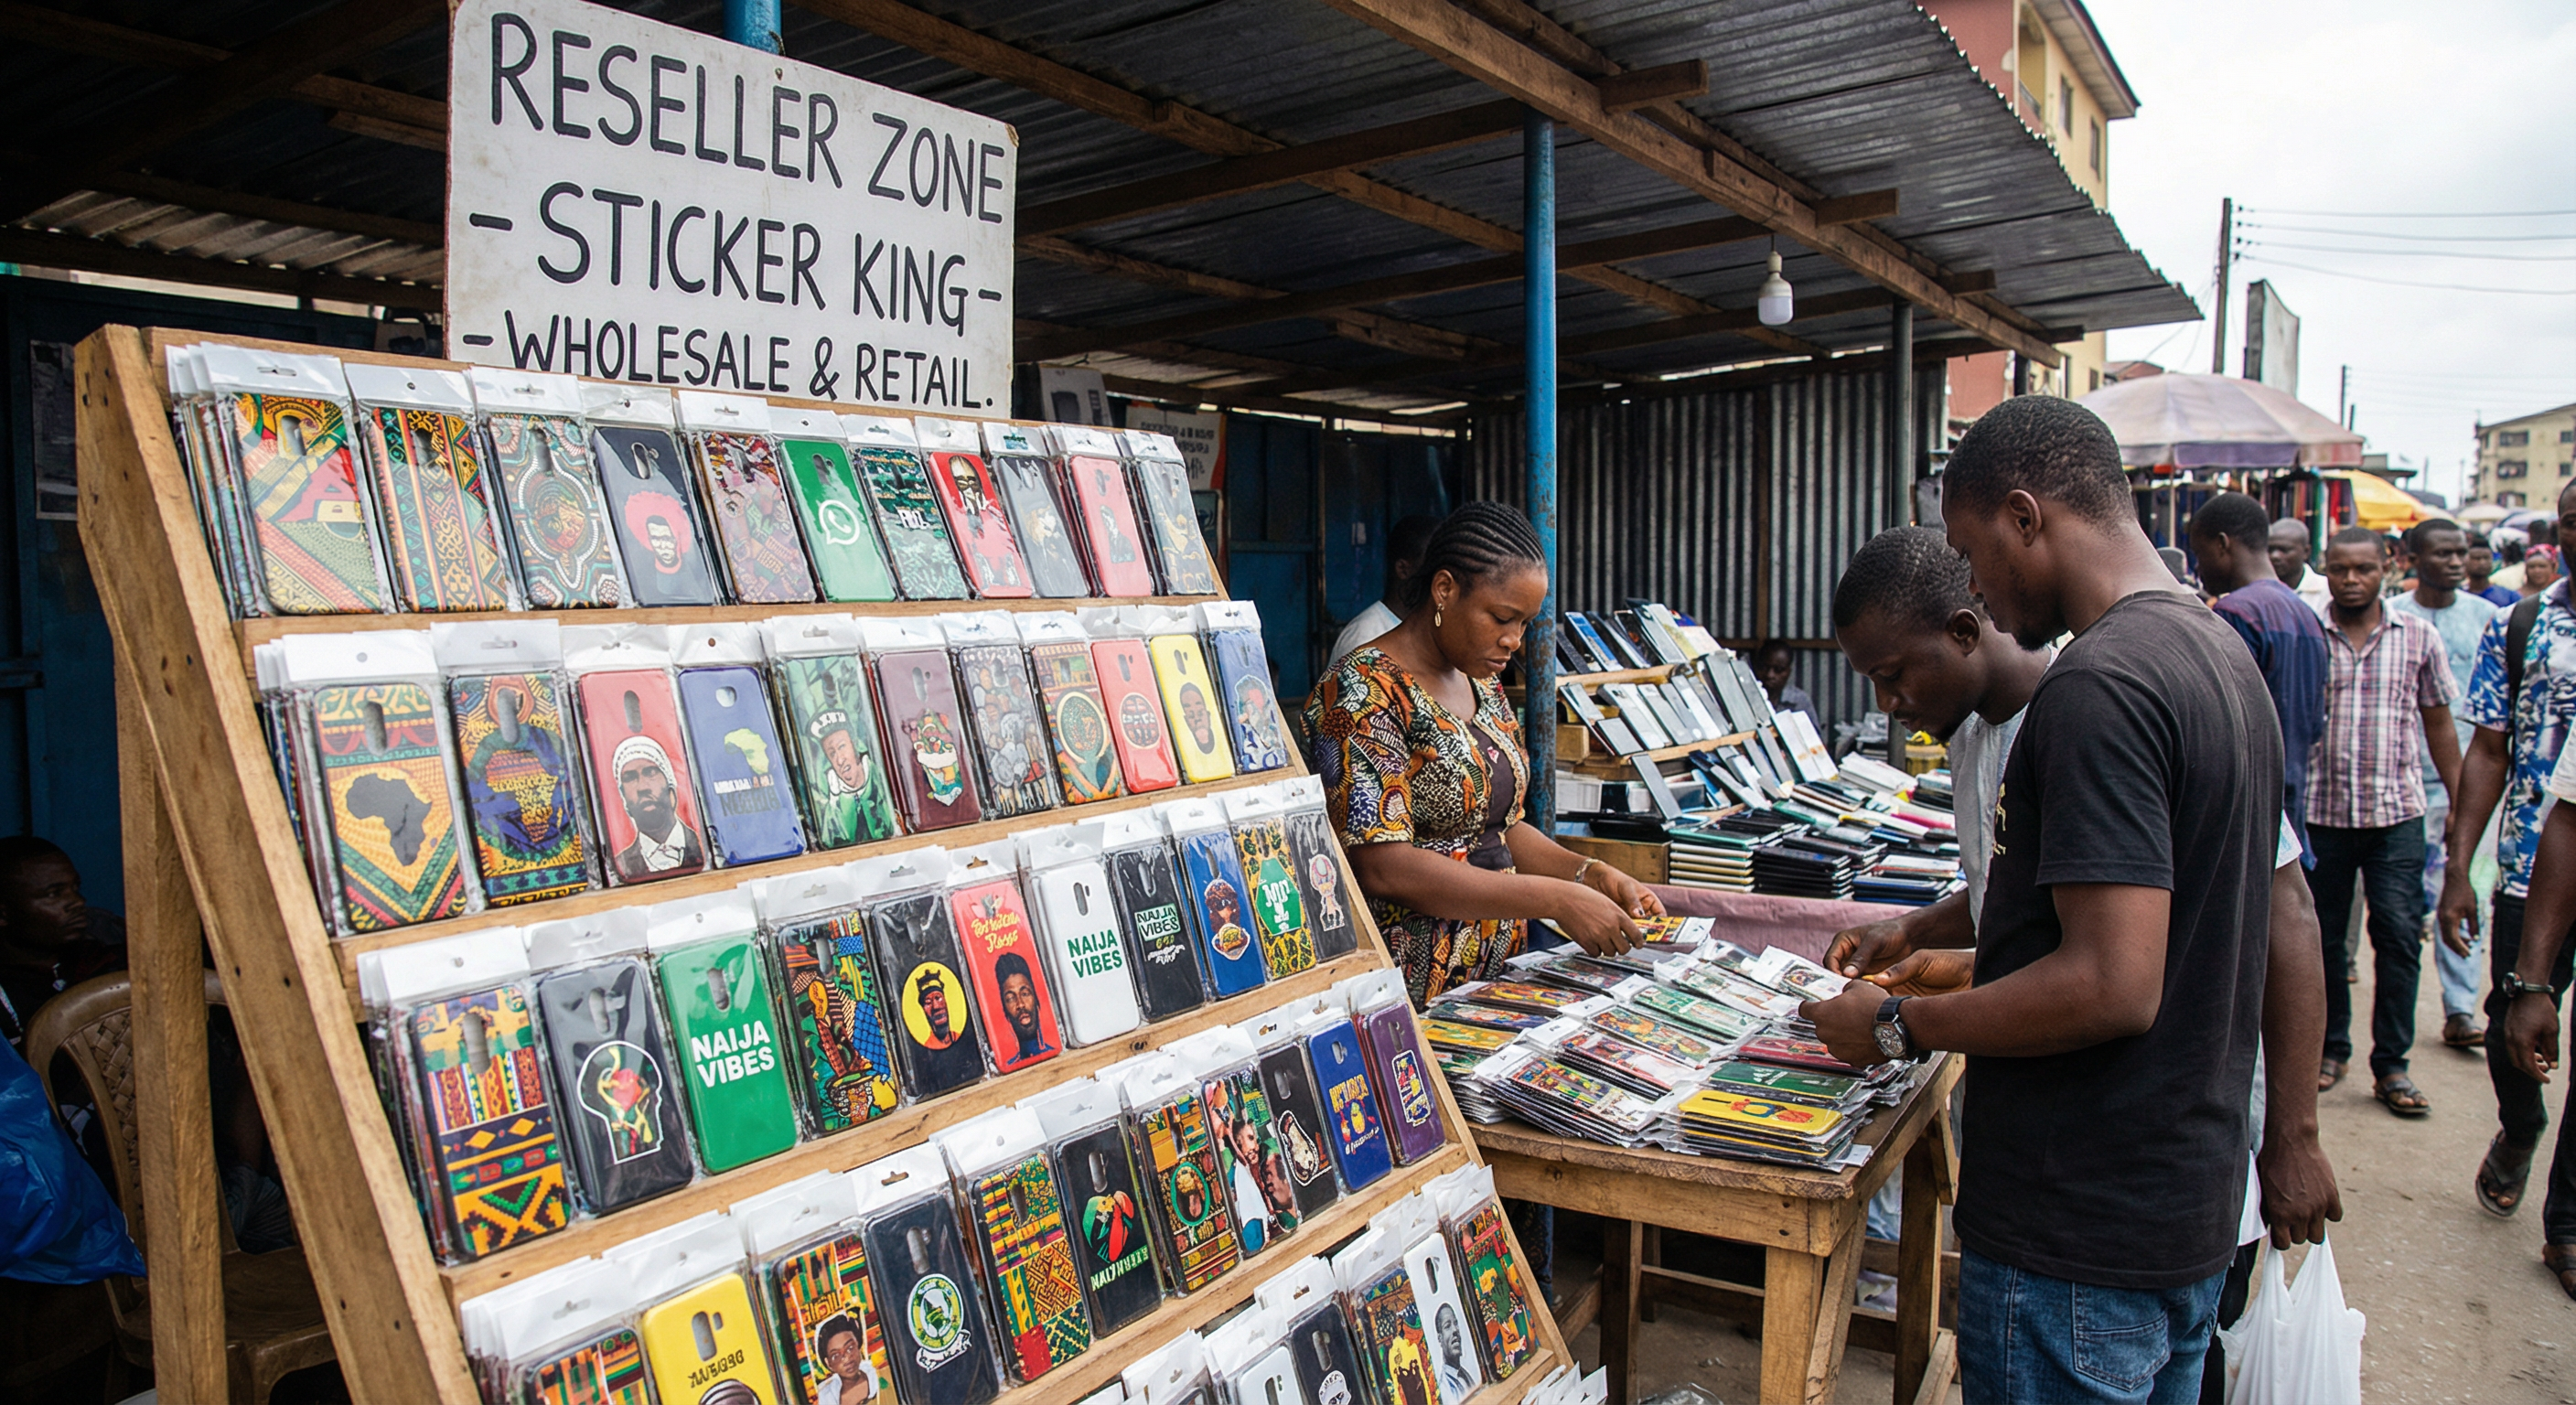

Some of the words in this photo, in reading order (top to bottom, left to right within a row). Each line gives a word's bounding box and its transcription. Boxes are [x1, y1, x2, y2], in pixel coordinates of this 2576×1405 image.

[491, 13, 842, 188] RESELLER
[868, 113, 1004, 223] ZONE
[538, 182, 825, 310] STICKER
[810, 337, 840, 401] &
[855, 343, 993, 409] RETAIL.
[1067, 929, 1118, 958] NAIJA
[1141, 917, 1179, 937] VIBES
[1072, 949, 1122, 978] VIBES
[691, 1020, 770, 1063] NAIJA
[696, 1046, 775, 1088] VIBES
